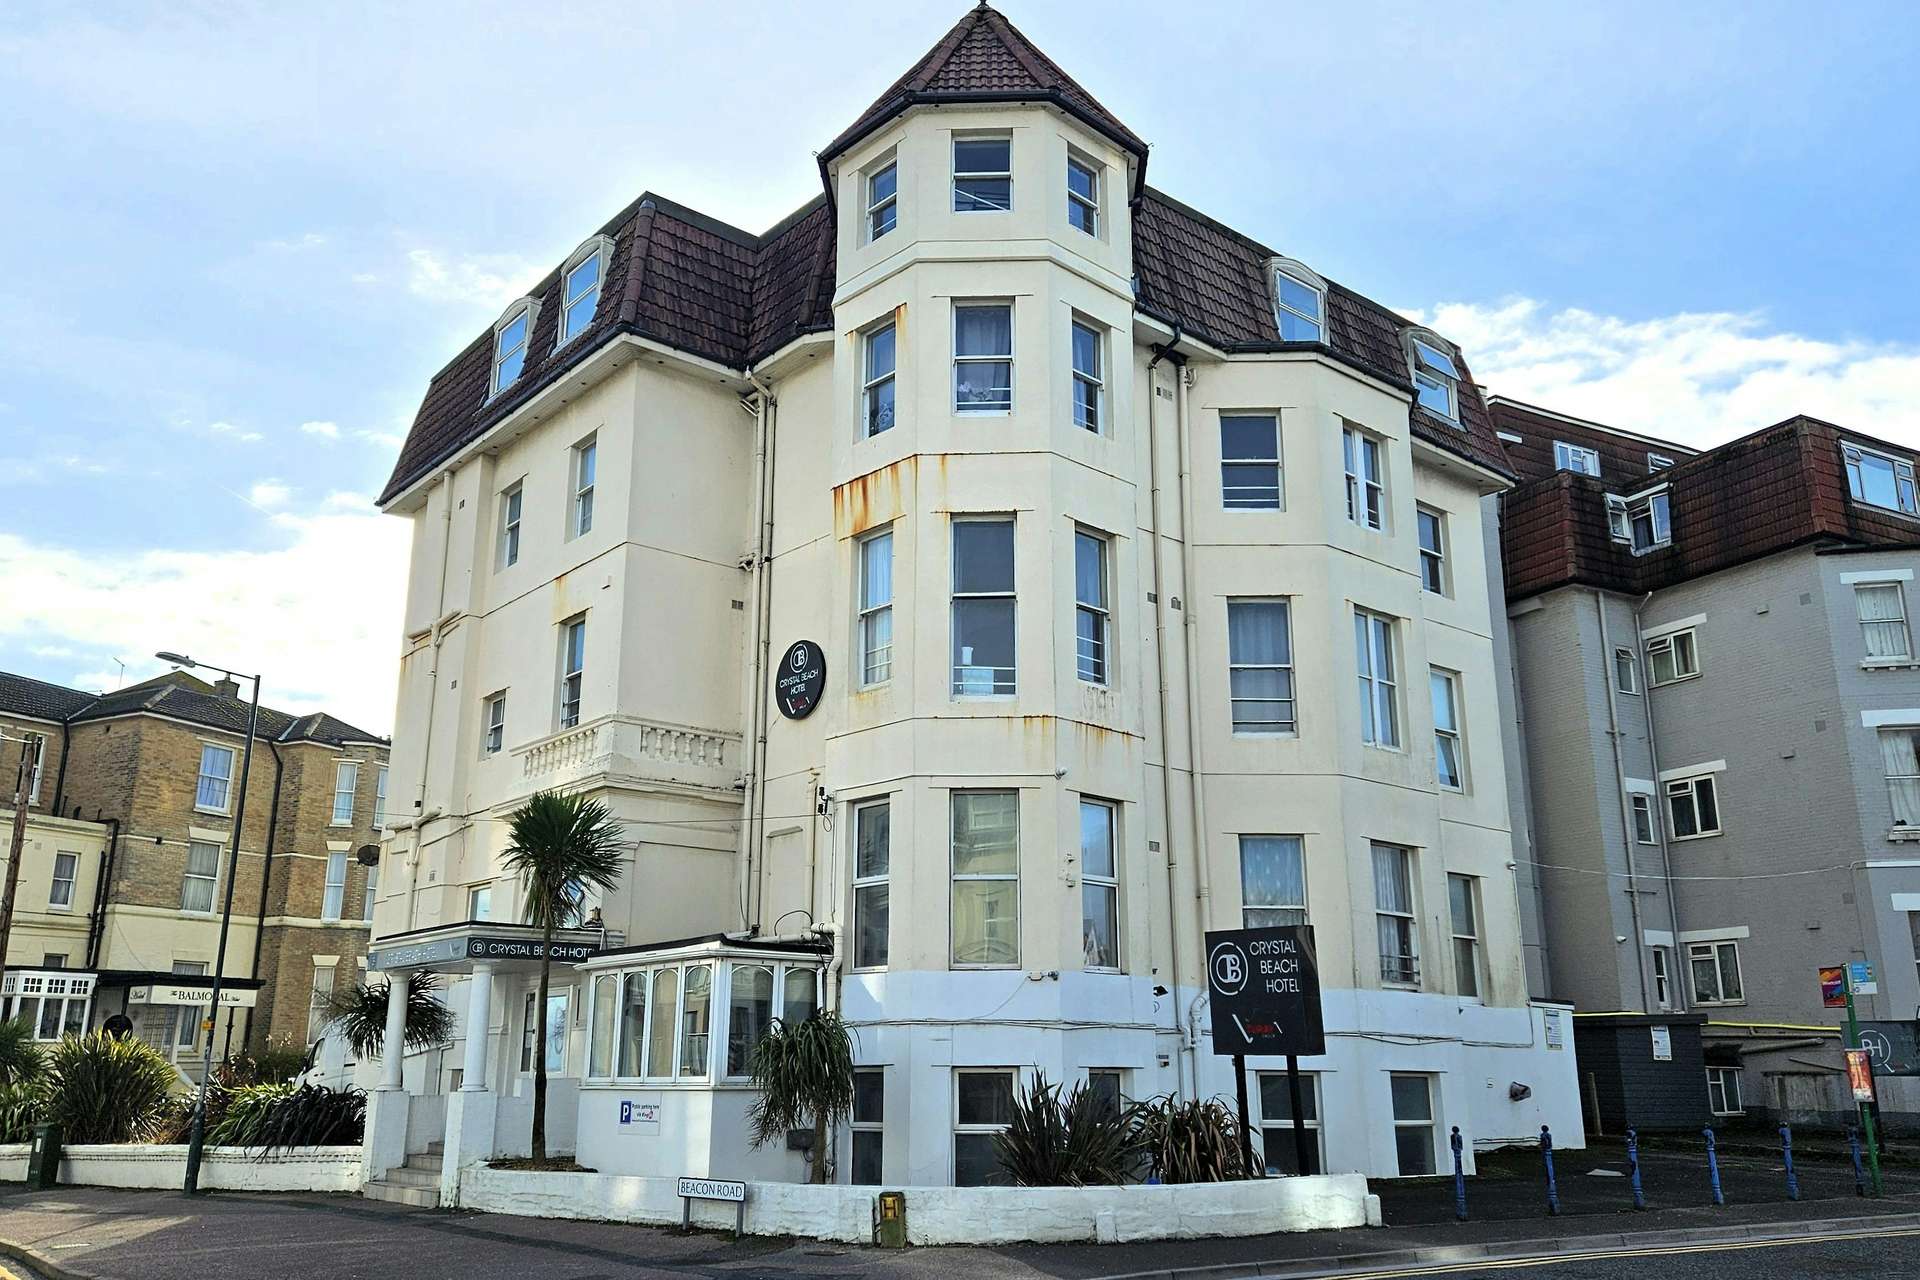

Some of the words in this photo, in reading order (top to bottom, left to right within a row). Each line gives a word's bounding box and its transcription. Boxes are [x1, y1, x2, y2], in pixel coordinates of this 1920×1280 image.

[780, 675, 800, 688] CRYSTAL
[801, 669, 818, 681] BEACH
[791, 683, 805, 695] HOTEL
[489, 943, 530, 956] CRYSTAL
[568, 947, 595, 958] HOT
[1249, 940, 1296, 955] CRYSTAL
[1260, 959, 1299, 974] BEACH
[1266, 978, 1300, 993] HOTEL
[178, 990, 229, 1002] BALMOAL
[623, 1104, 630, 1121] P
[680, 1181, 716, 1195] BEACON
[717, 1184, 743, 1198] ROAD
